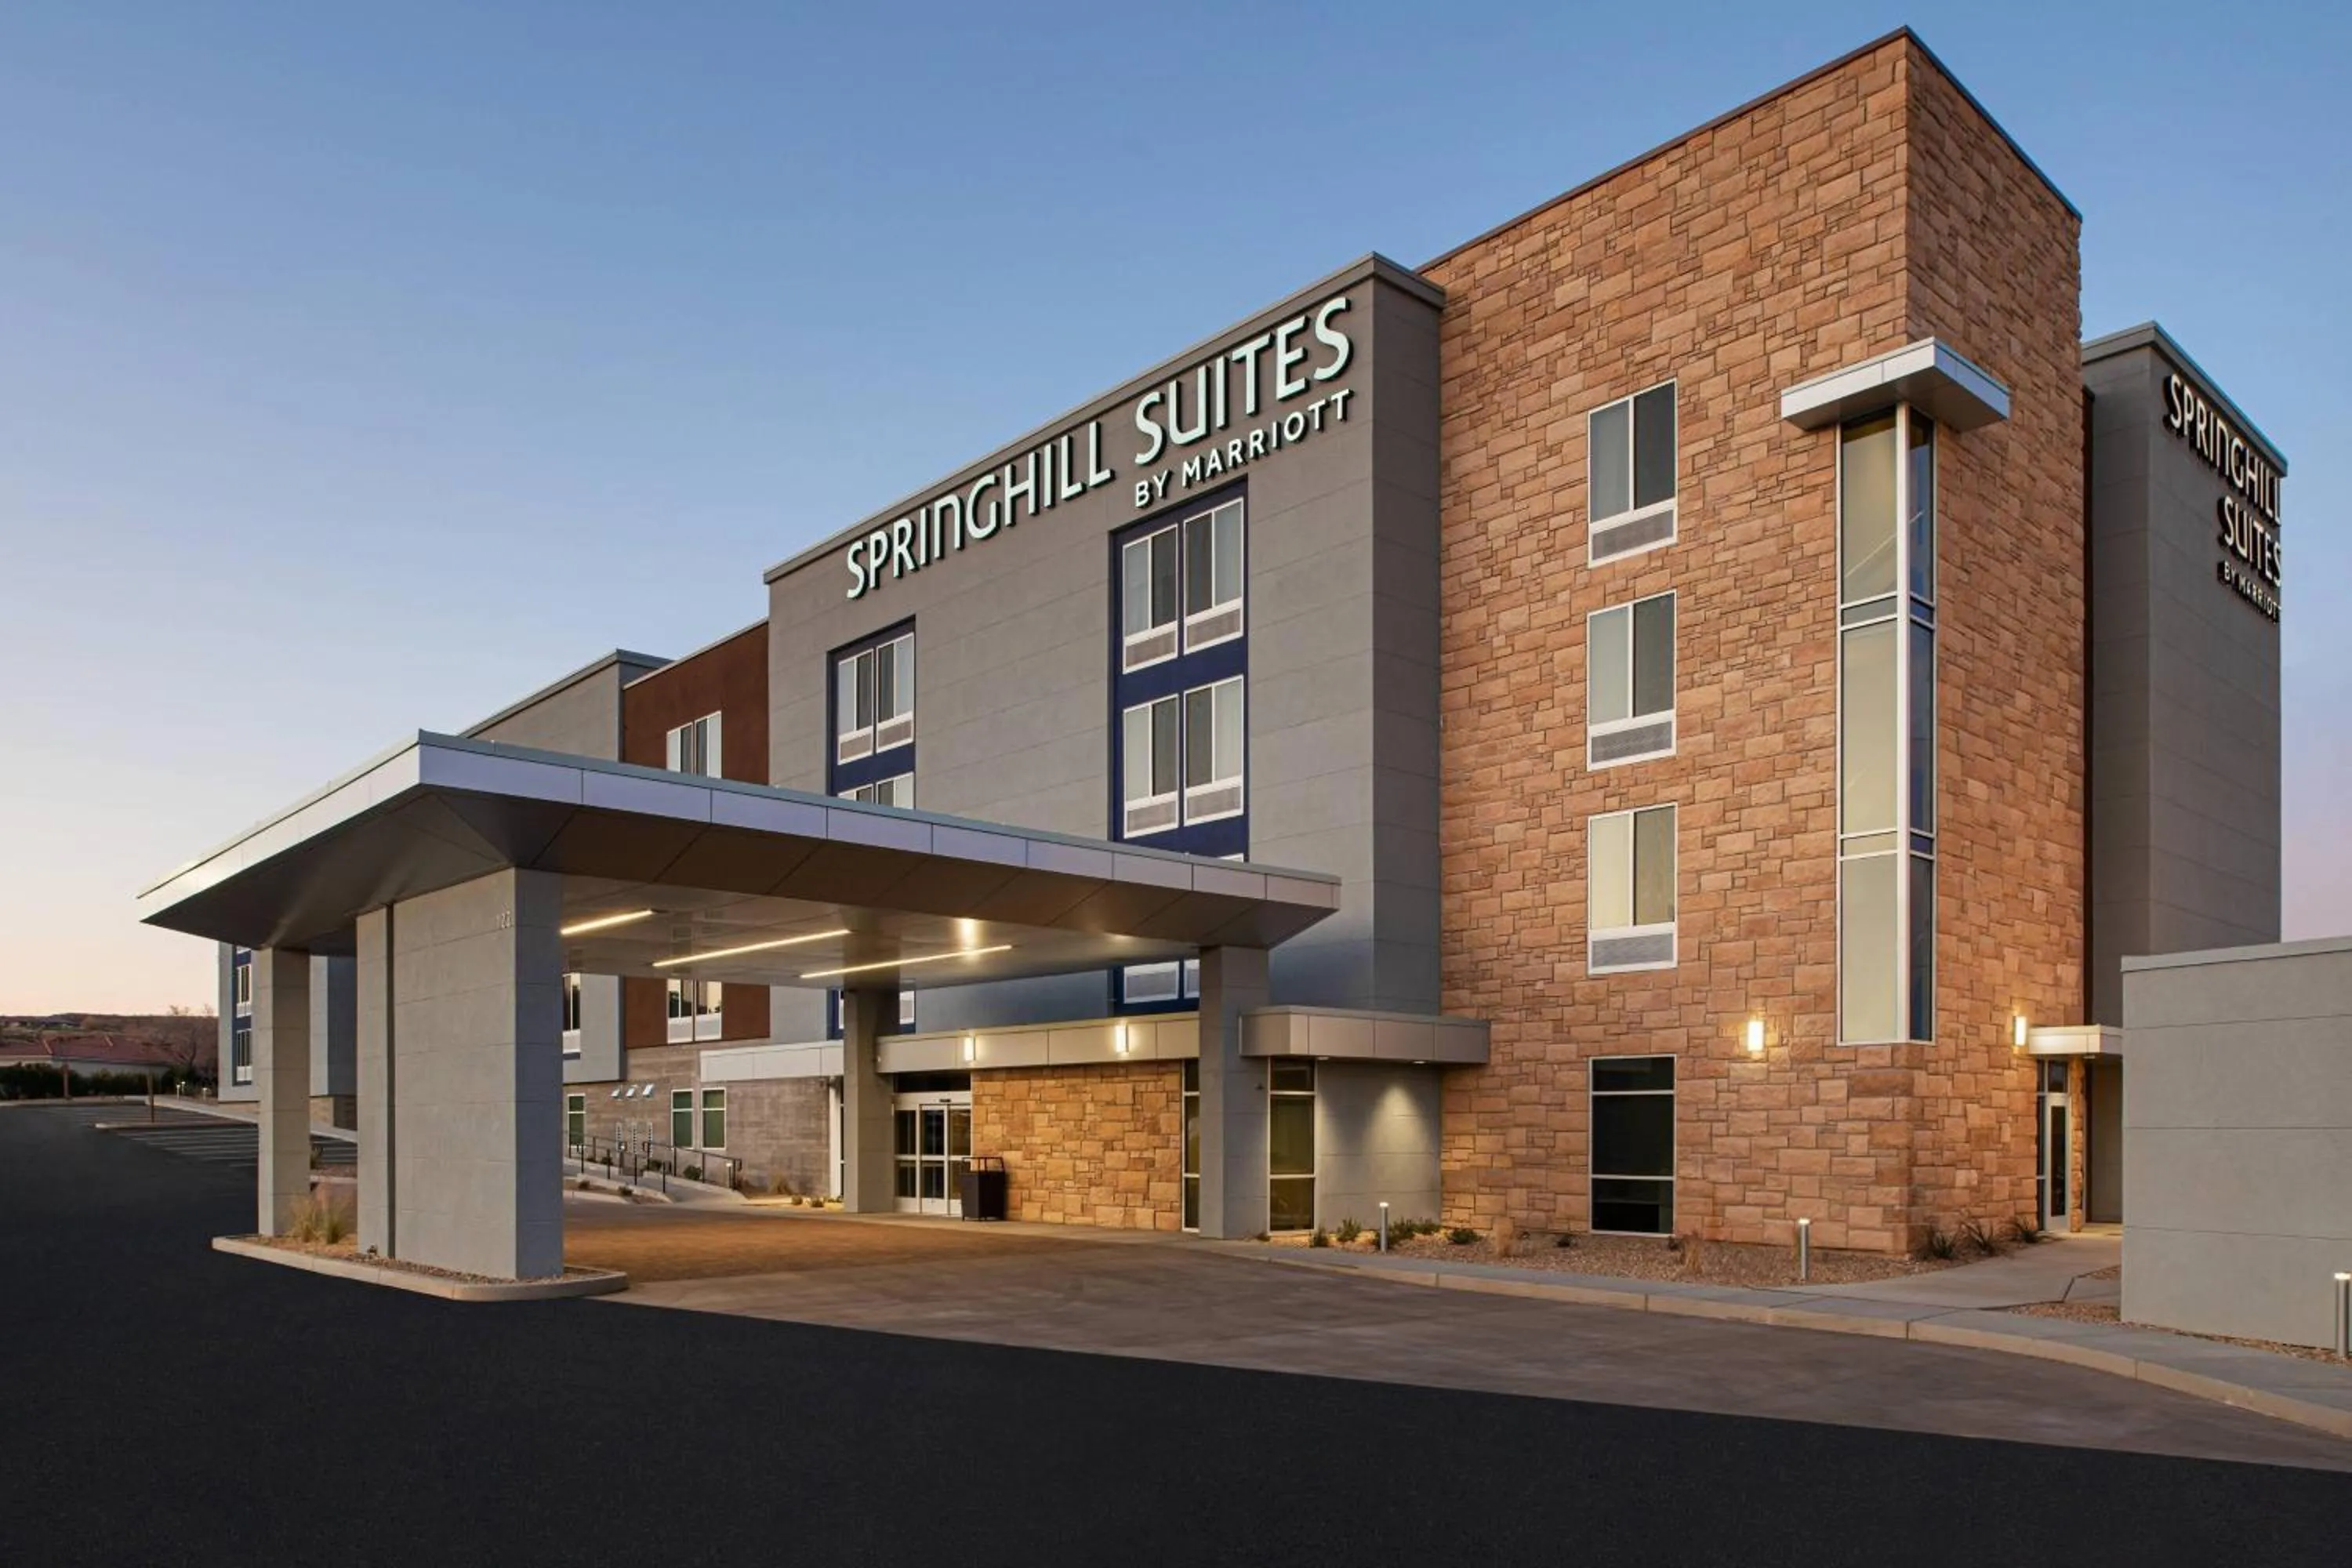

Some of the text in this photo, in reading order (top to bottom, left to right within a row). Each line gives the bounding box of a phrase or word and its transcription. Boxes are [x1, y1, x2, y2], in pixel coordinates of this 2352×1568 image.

[846, 296, 1351, 600] SPRINGHILL SUITES
[1135, 388, 1351, 508] BY MARRIOTT
[2224, 495, 2281, 587] SUITES
[2224, 561, 2236, 582] BY
